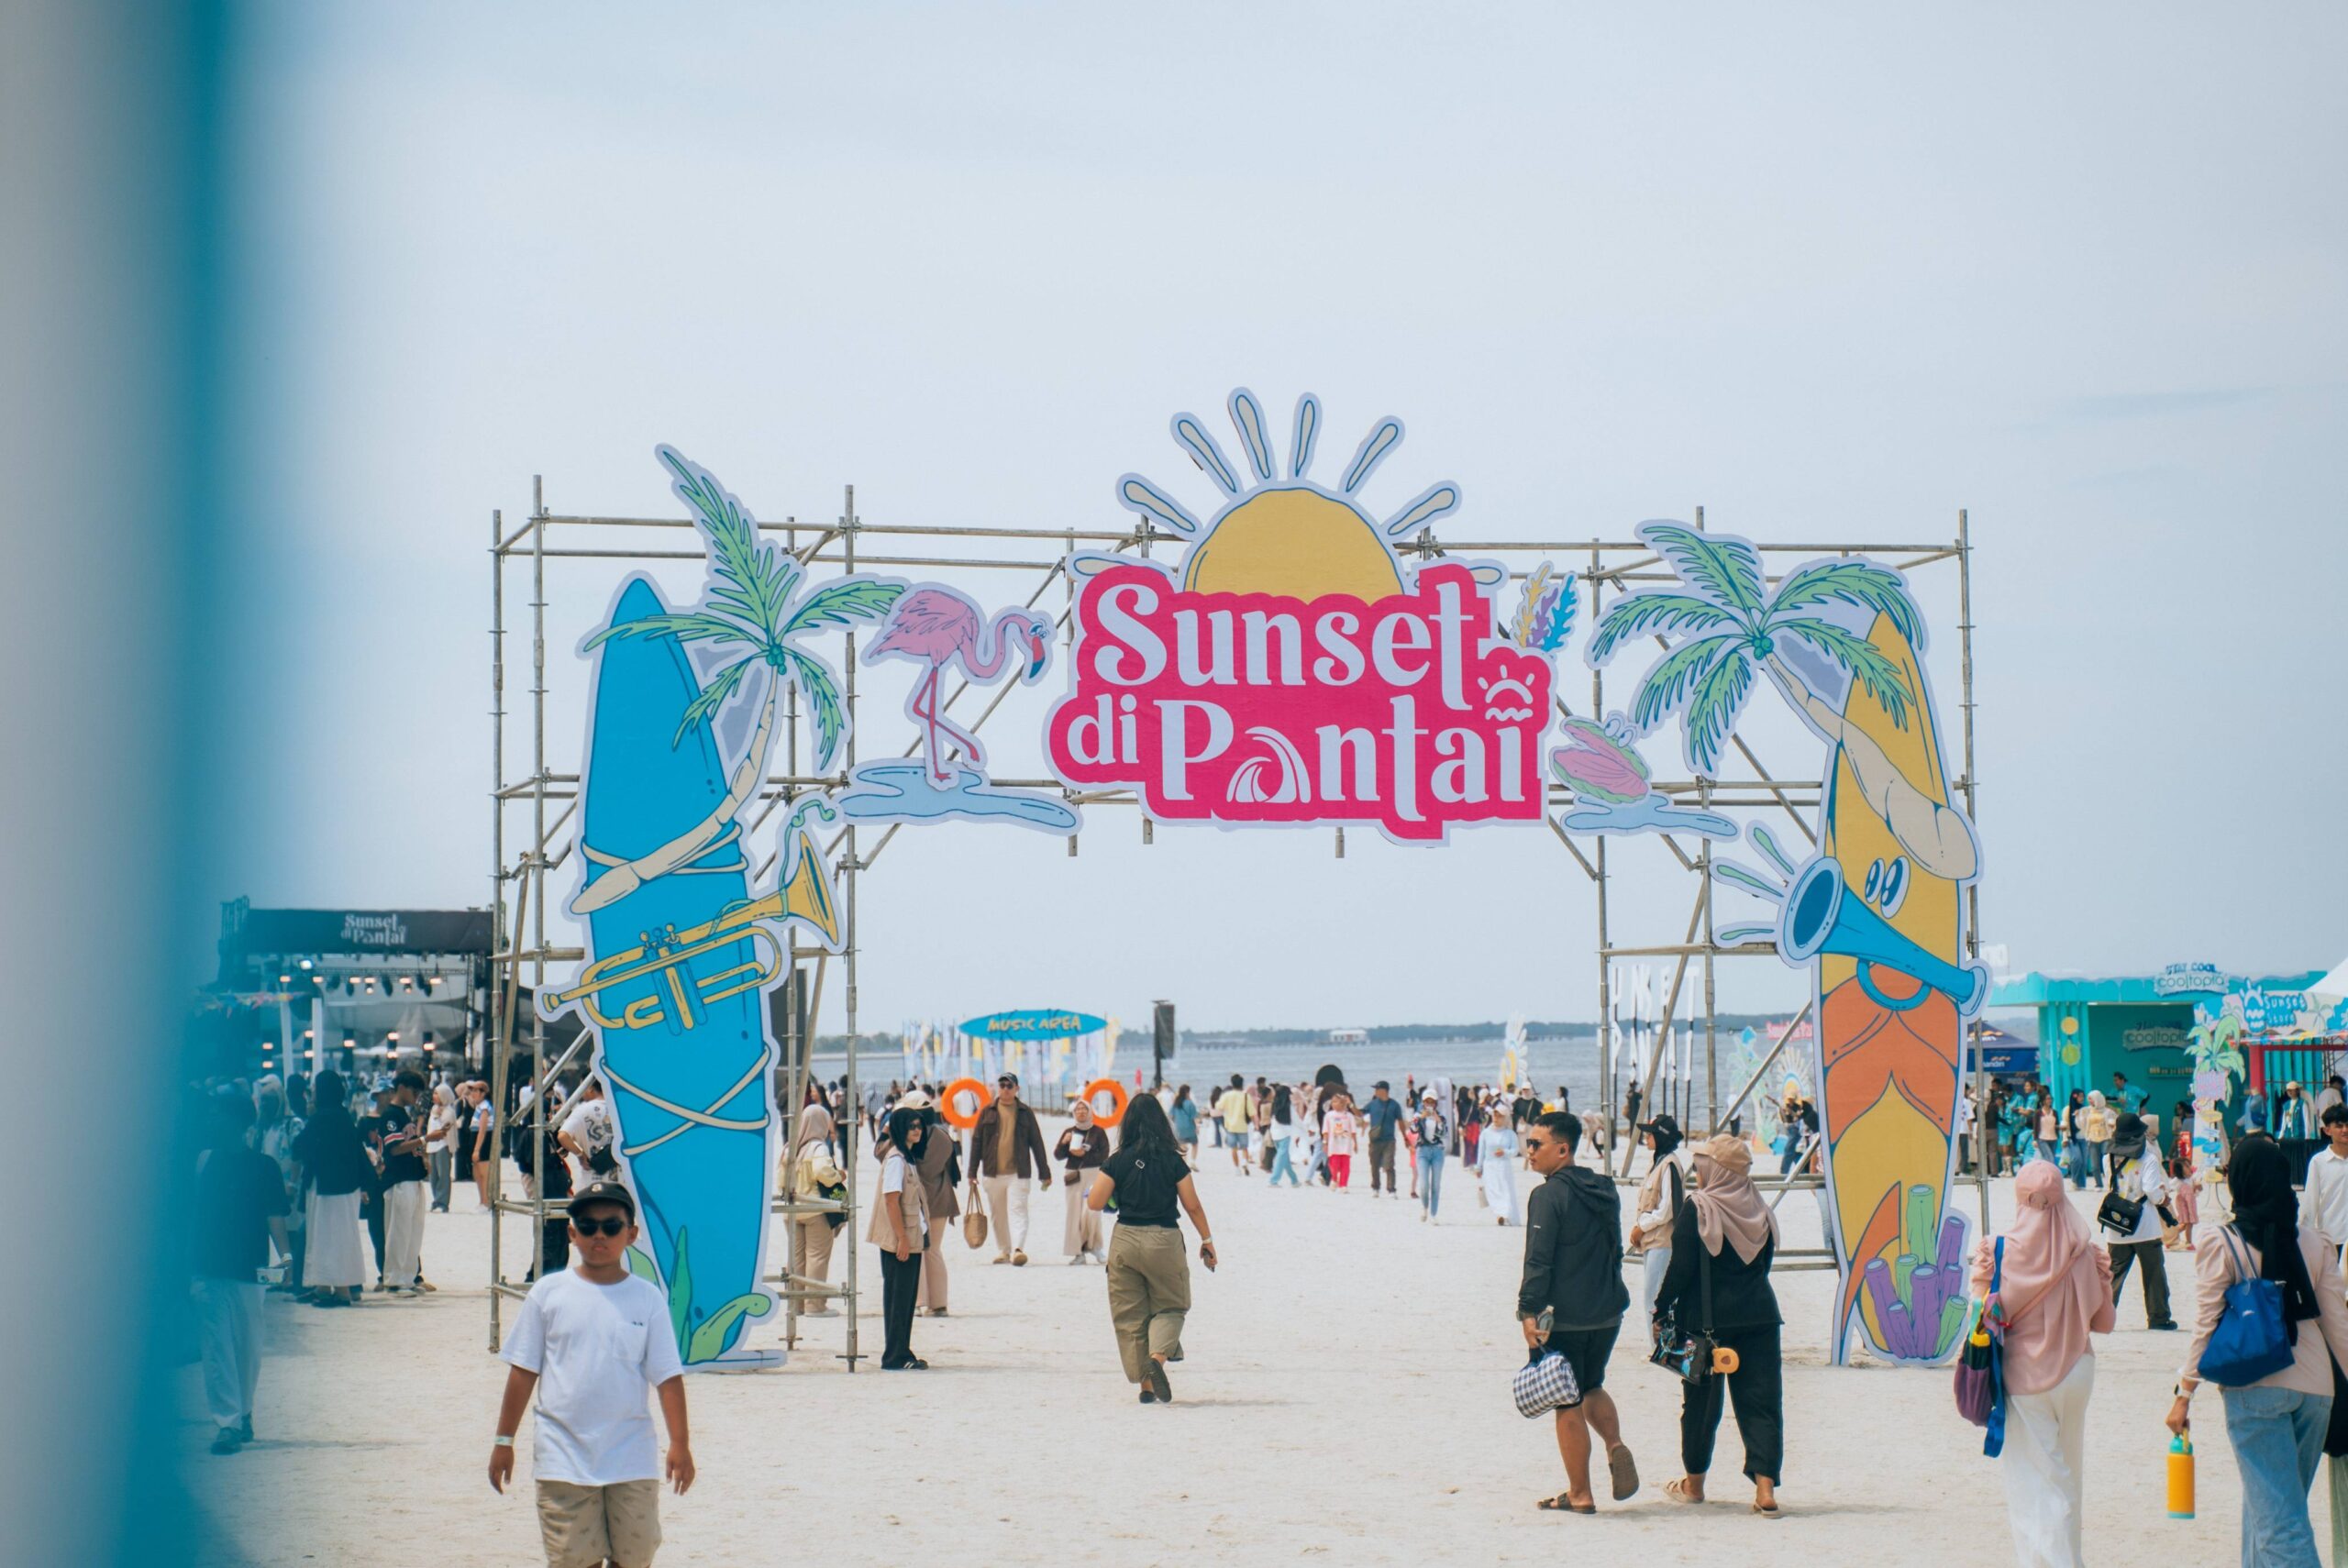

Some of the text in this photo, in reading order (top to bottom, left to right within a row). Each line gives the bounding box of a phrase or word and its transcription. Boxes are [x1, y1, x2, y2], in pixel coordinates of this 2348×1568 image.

[1094, 580, 1474, 711] Sunset
[1067, 693, 1526, 822] di Pantai
[345, 913, 398, 931] Sunset
[353, 926, 406, 946] Pantai
[2157, 974, 2224, 988] cooltopia
[988, 1015, 1080, 1032] MUSIC AREA
